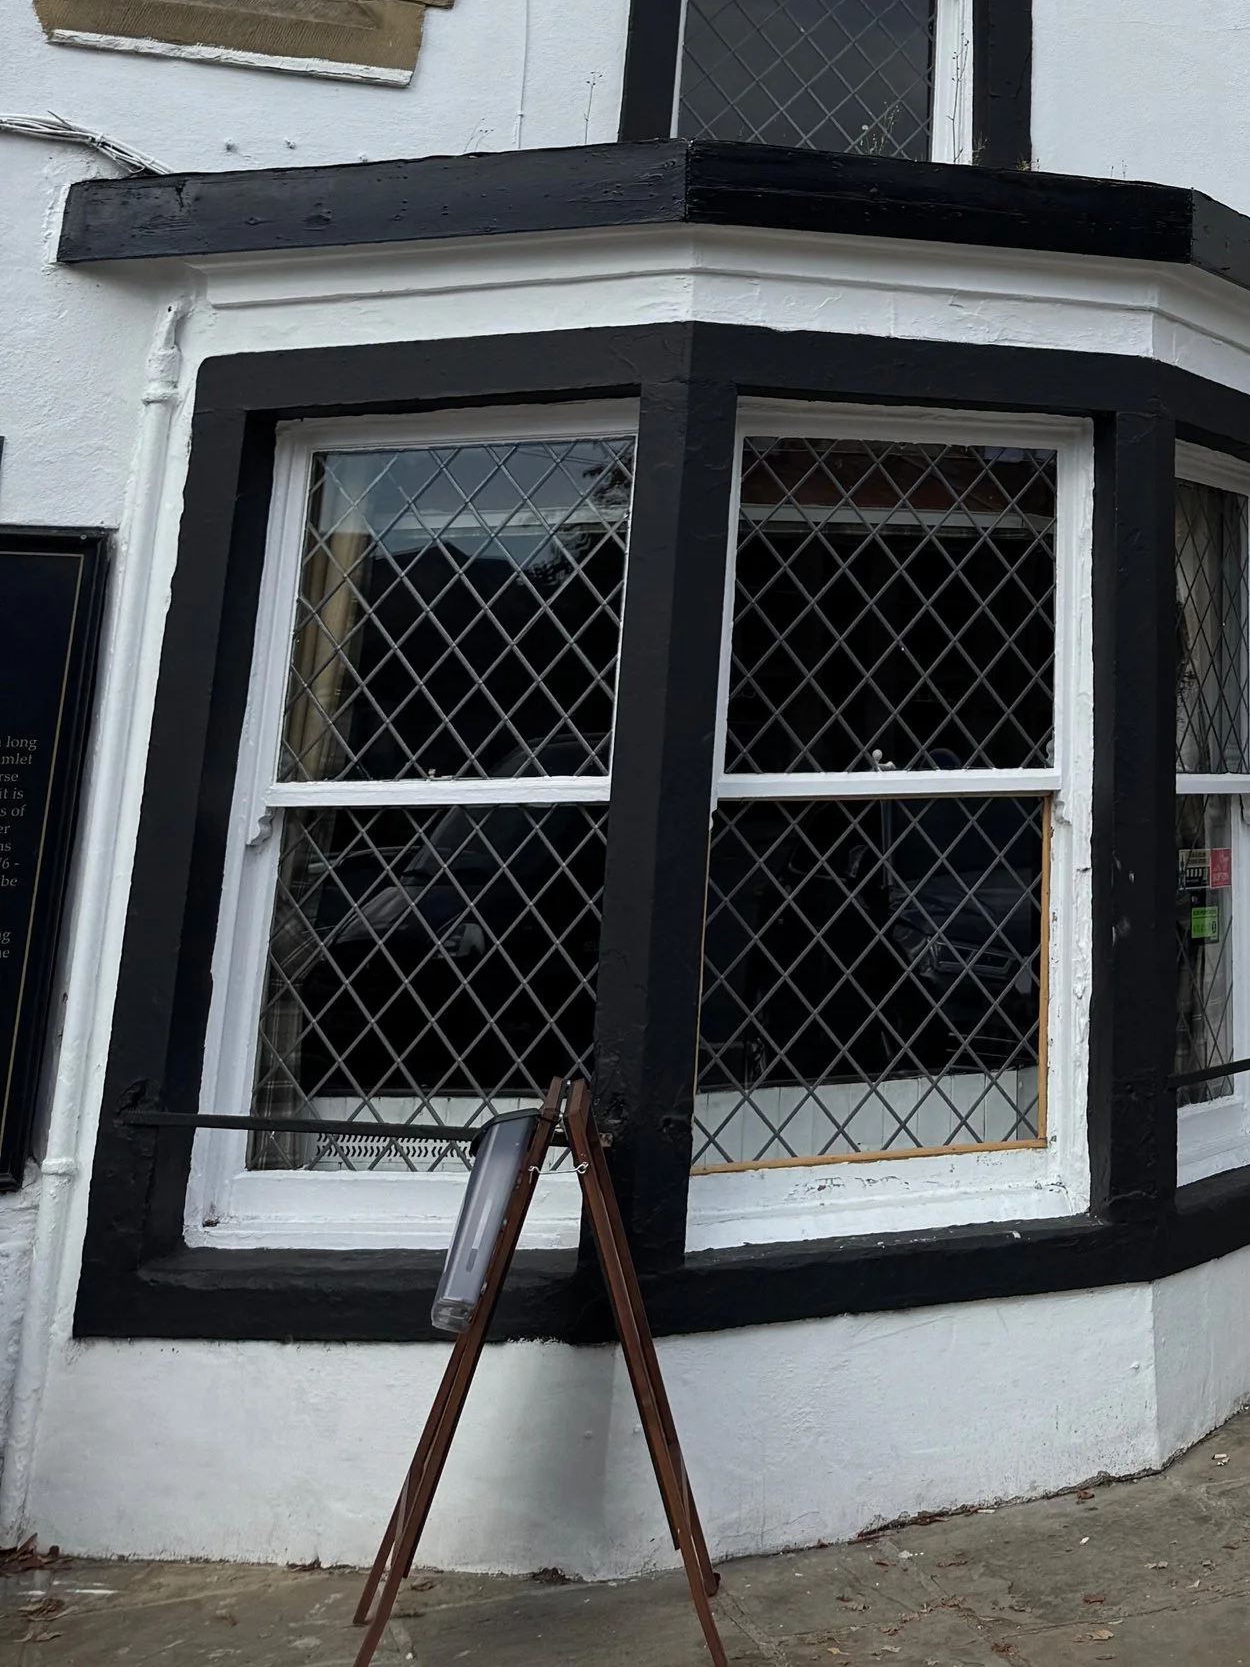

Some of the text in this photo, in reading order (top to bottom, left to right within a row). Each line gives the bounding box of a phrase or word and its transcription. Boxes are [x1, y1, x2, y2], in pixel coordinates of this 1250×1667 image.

[6, 736, 38, 751] long
[12, 787, 24, 799] is
[11, 804, 27, 817] of
[1, 875, 18, 887] be
